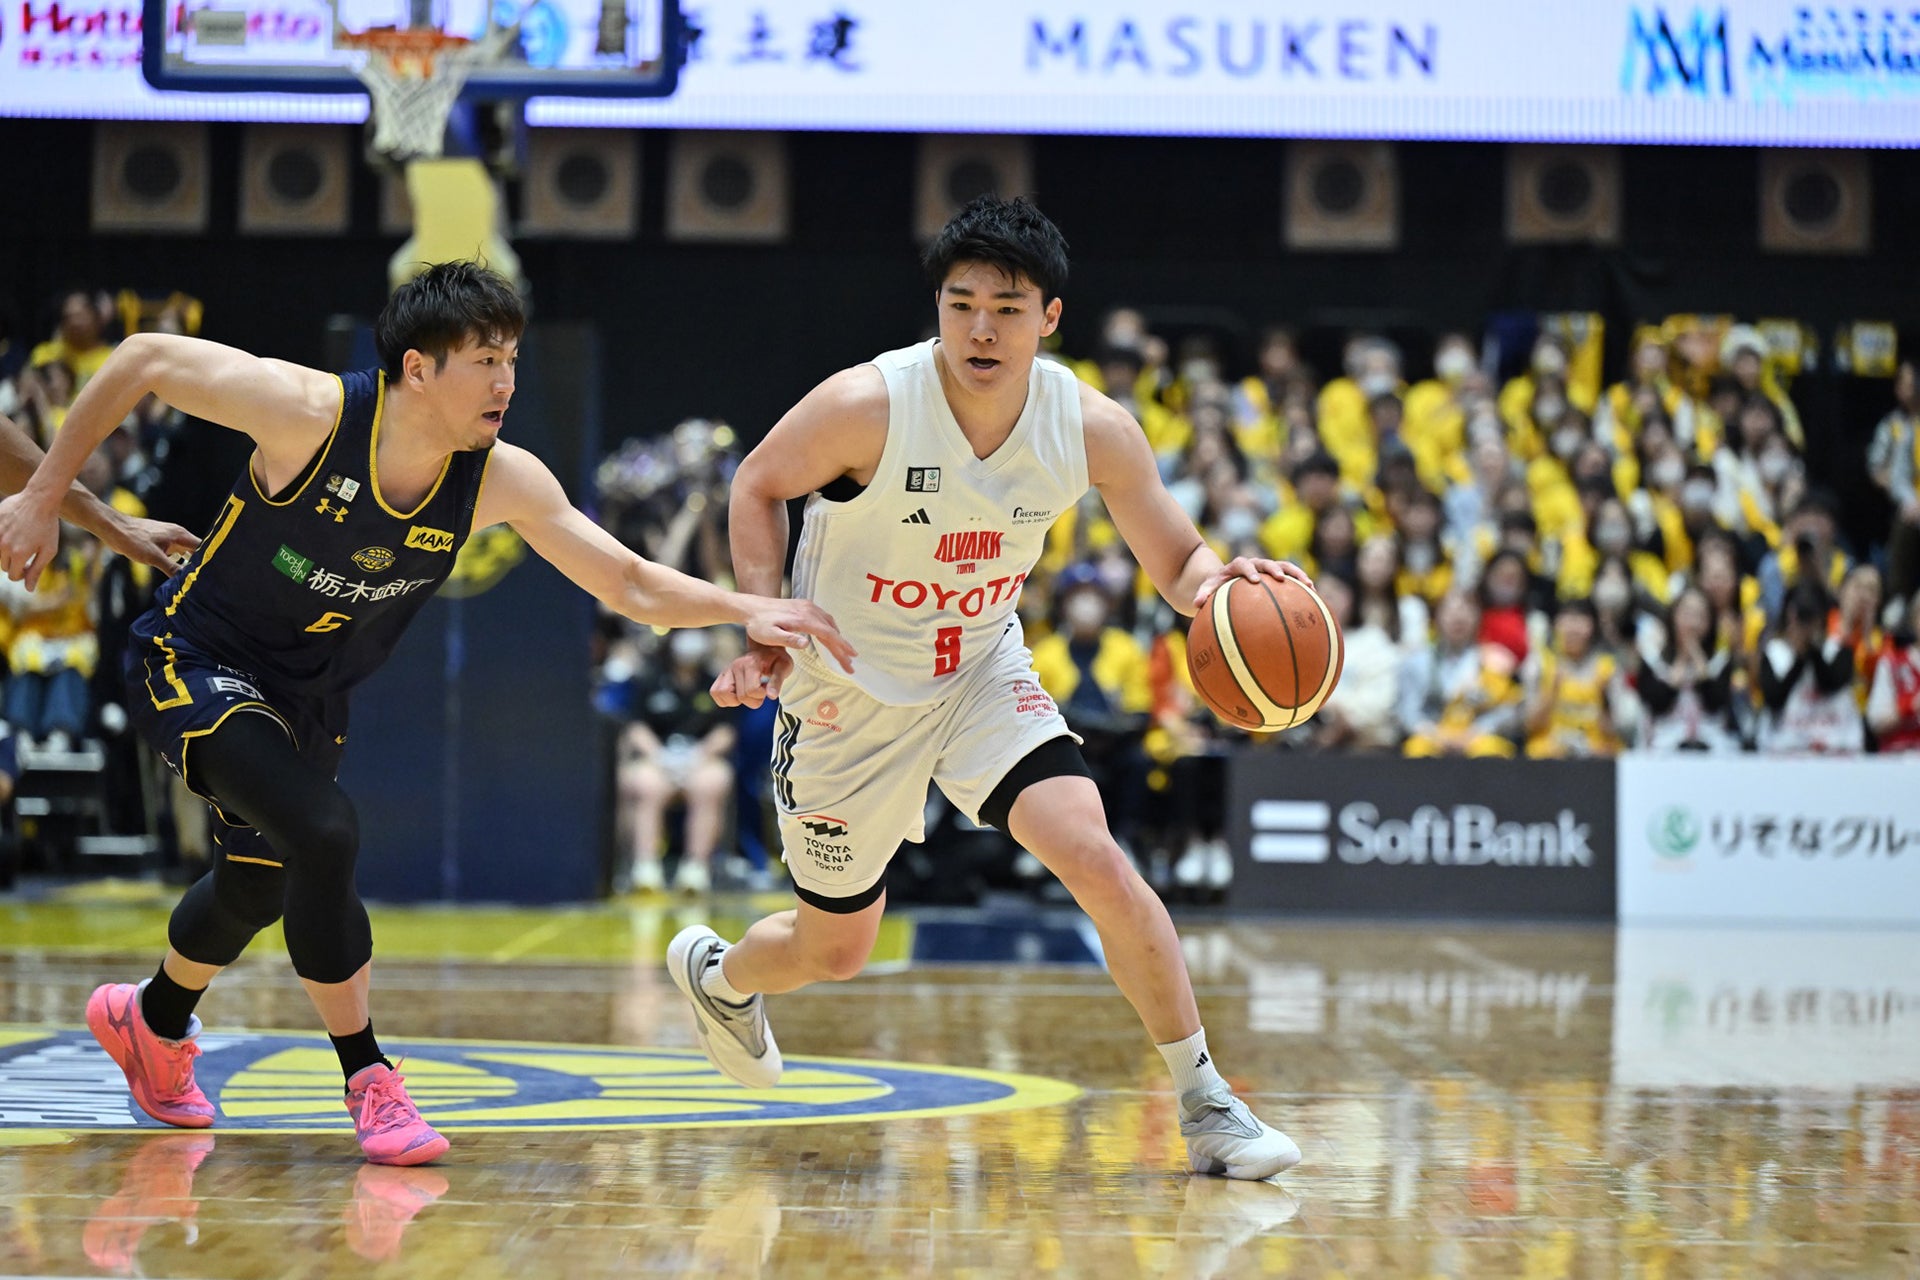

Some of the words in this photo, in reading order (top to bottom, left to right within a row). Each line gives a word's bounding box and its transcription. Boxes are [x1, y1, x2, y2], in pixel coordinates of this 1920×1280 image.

[1025, 17, 1438, 80] MASUKEN
[934, 531, 1005, 563] ALVARK
[956, 563, 976, 575] TOKYO
[307, 567, 435, 603] 栃木銀行
[304, 611, 352, 632] 6
[933, 626, 963, 677] 9
[804, 836, 851, 854] TOYOTA
[1338, 801, 1596, 867] SoftBank
[806, 847, 853, 863] ARENA
[814, 860, 844, 872] TOKYO
